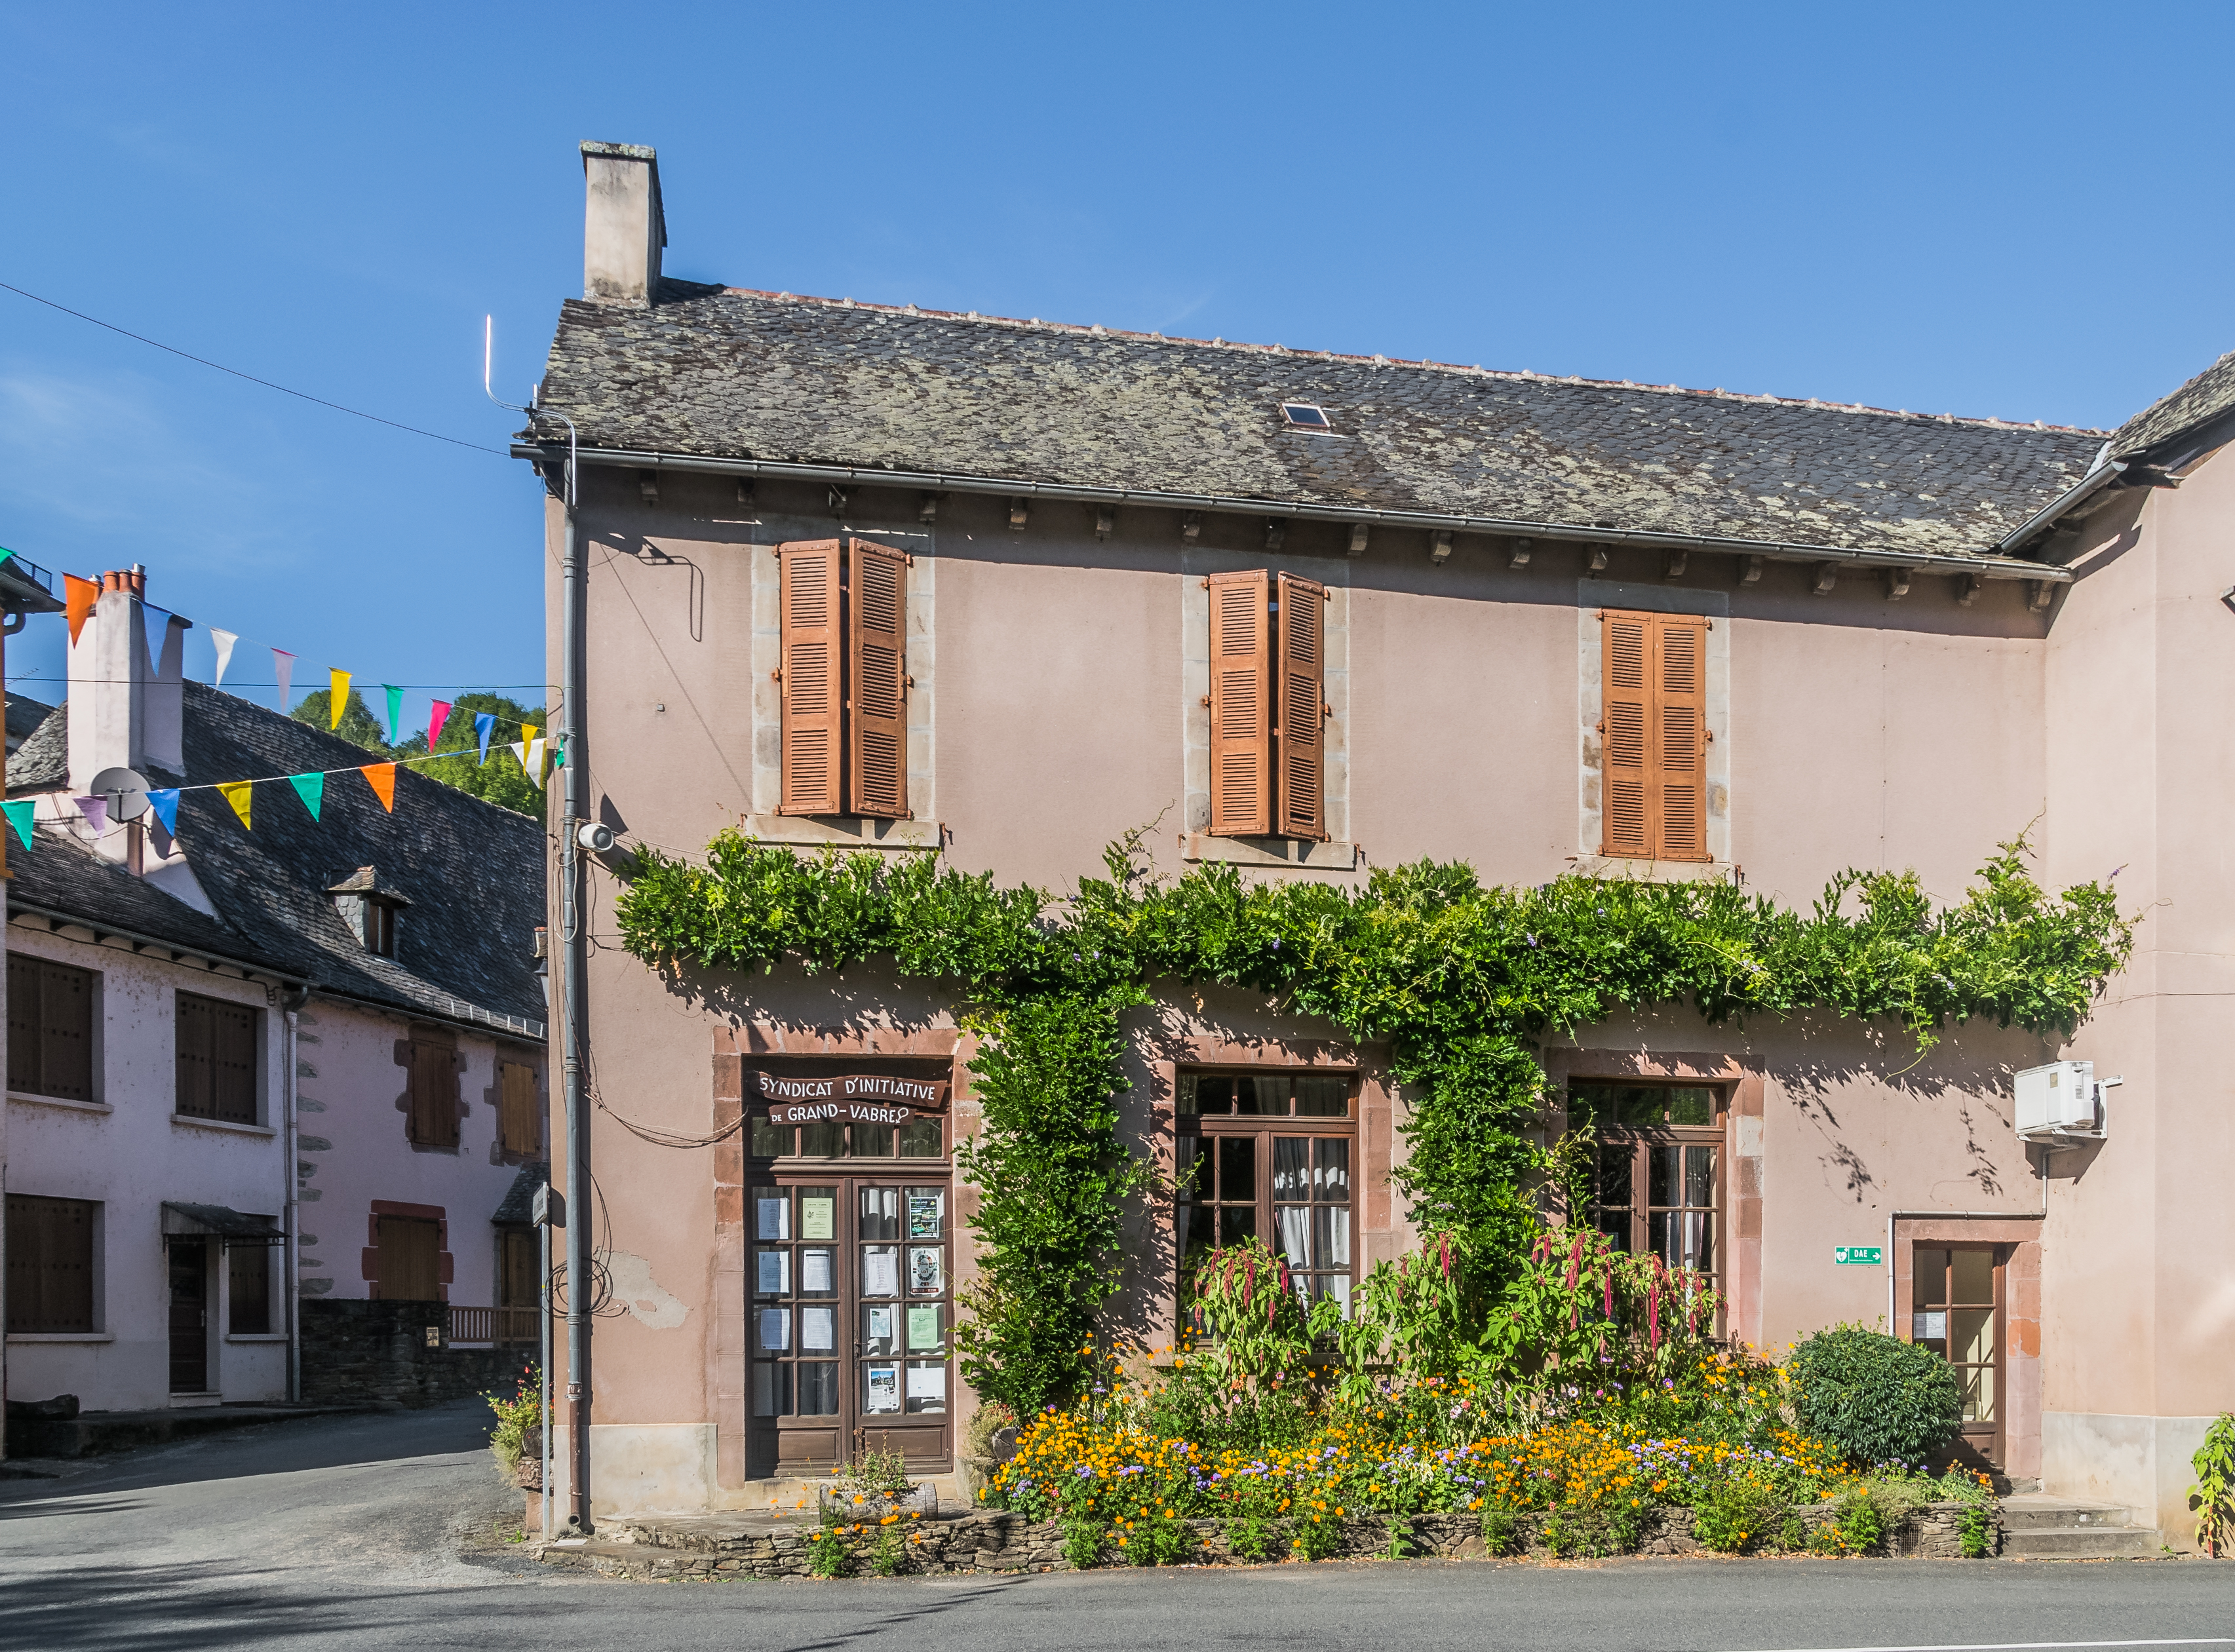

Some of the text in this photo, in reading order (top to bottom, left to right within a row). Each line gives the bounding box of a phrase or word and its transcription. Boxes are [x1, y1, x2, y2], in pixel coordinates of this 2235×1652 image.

[760, 1077, 935, 1100] SYNDICAT D'INITIATIVE
[771, 1114, 783, 1123] DE
[1854, 1249, 1868, 1258] DAE
